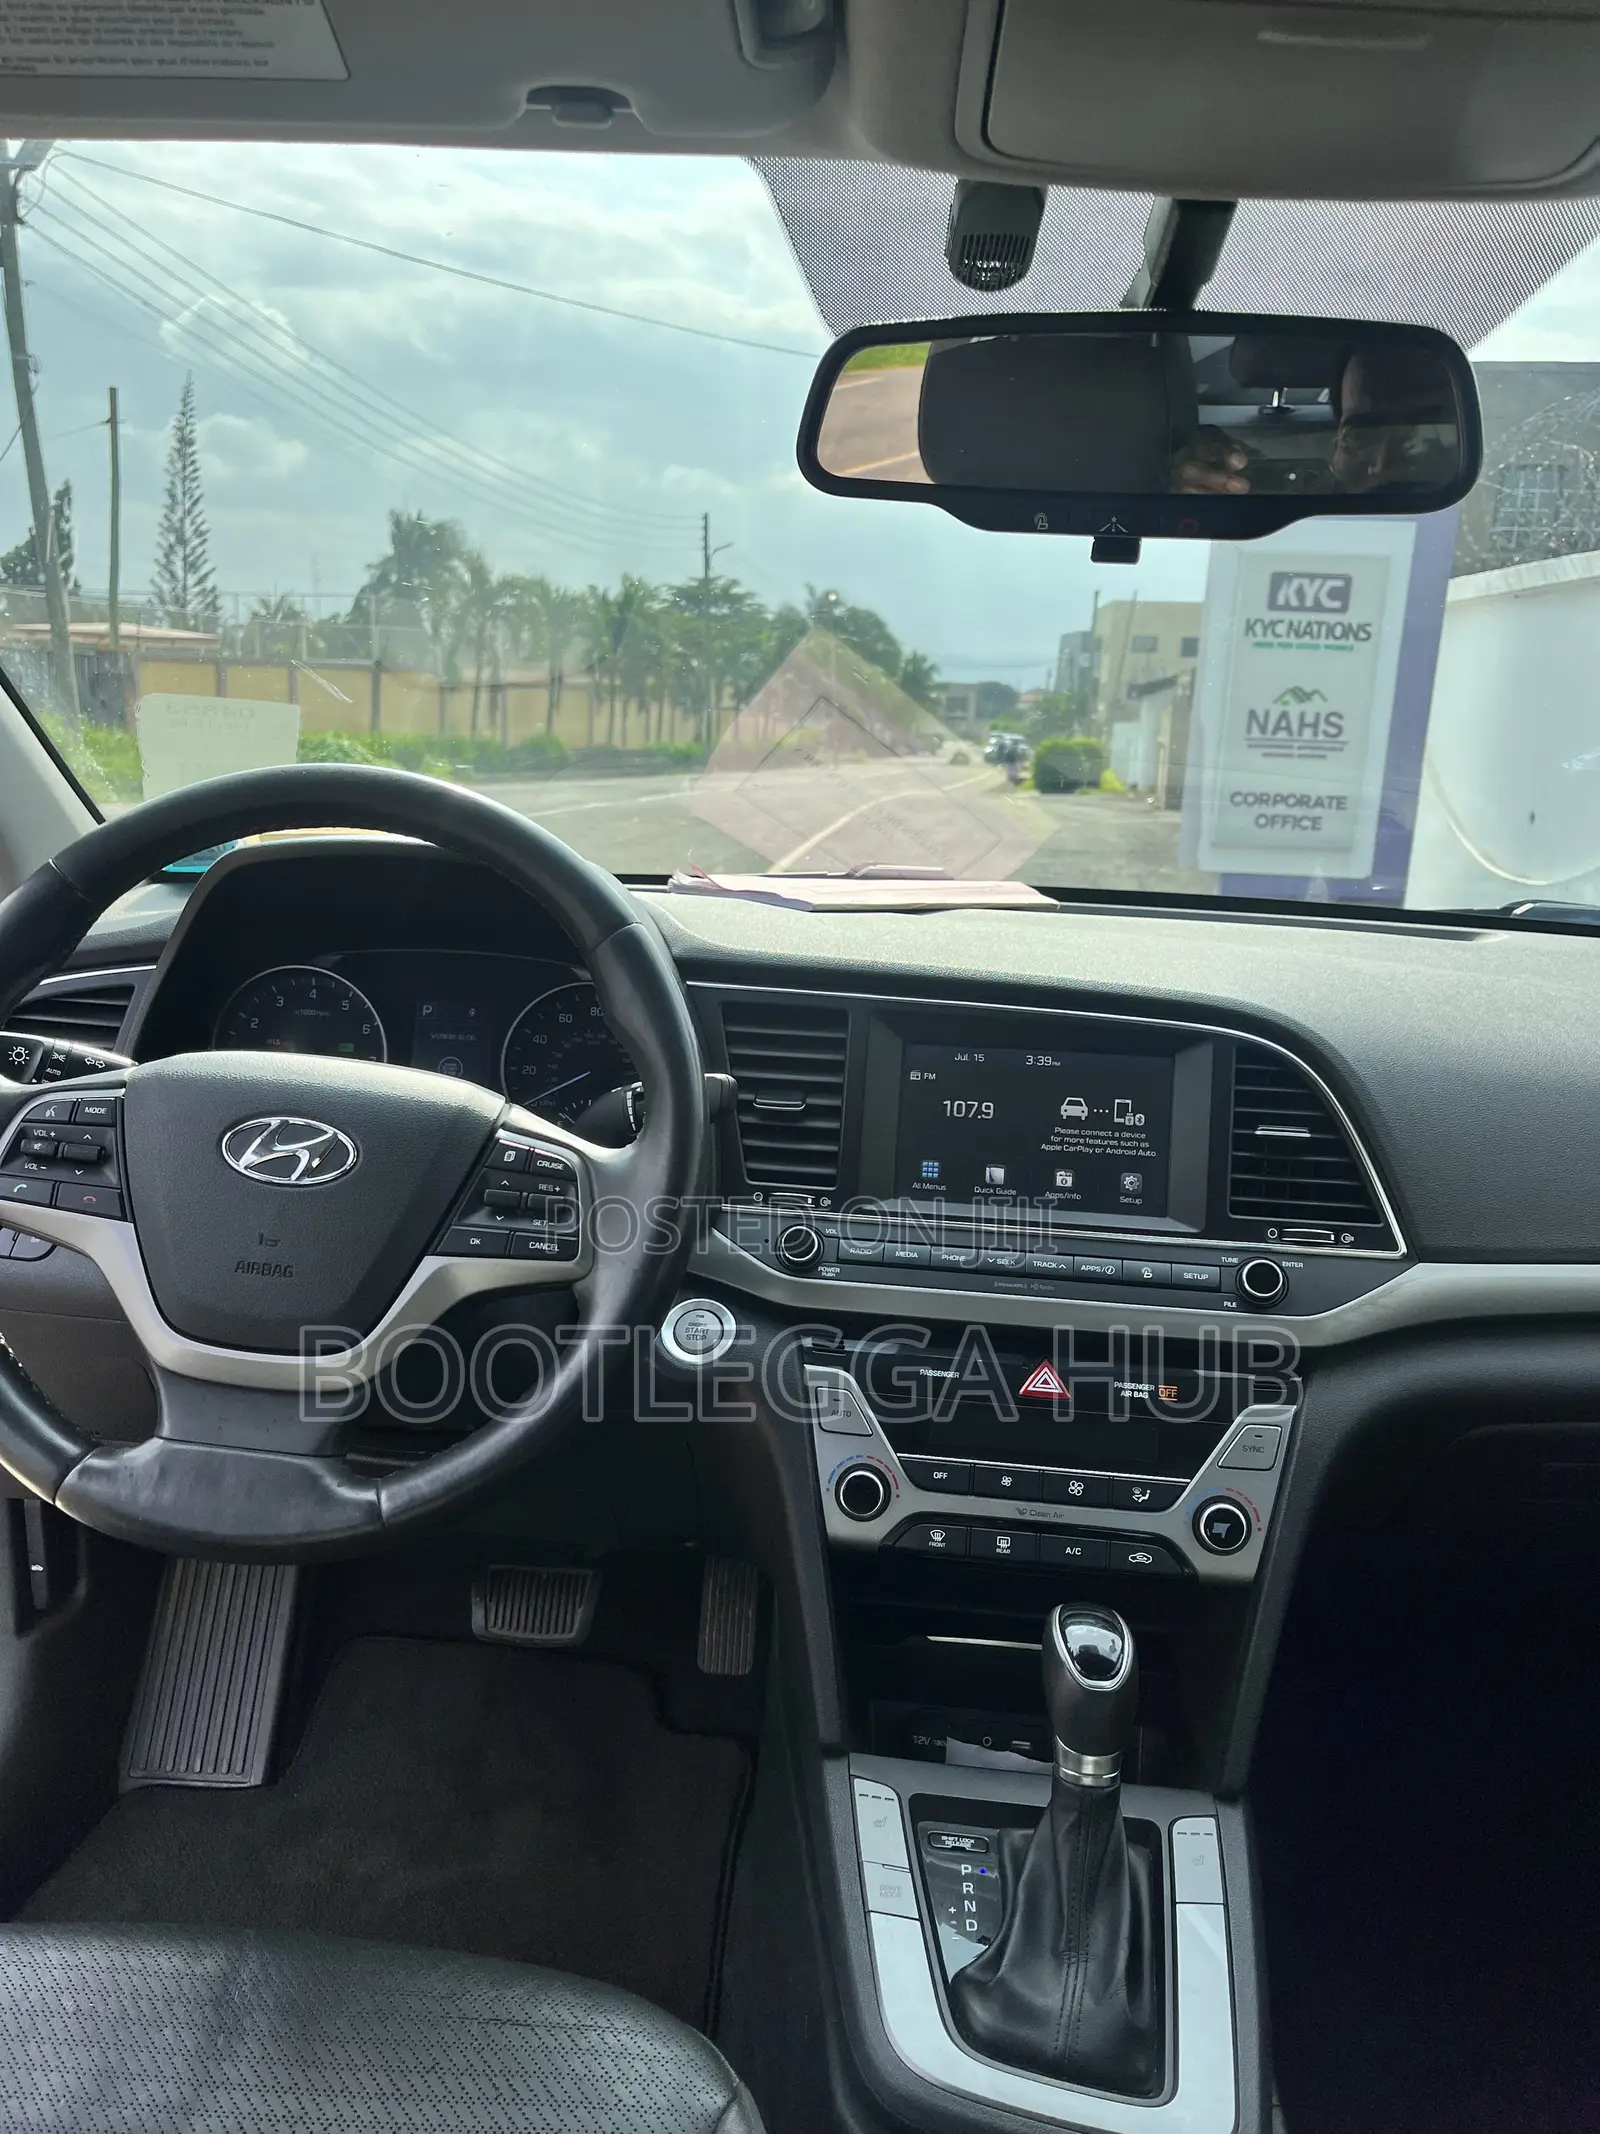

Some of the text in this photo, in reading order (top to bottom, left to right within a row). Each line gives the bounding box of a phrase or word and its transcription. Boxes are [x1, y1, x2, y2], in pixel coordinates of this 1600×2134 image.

[1276, 577, 1346, 609] KYC
[1245, 708, 1346, 740] NAHS
[1229, 790, 1348, 812] CORPORATE
[1254, 813, 1323, 832] OFFICE
[309, 988, 317, 1000] 4
[276, 996, 284, 1007] 3
[341, 1000, 350, 1011] 5
[422, 1004, 433, 1017] P
[250, 1017, 259, 1029] 2
[558, 1013, 573, 1023] 60
[362, 1023, 371, 1035] 6
[532, 1034, 548, 1044] 40
[973, 1053, 985, 1062] 15
[45, 1067, 62, 1077] AUTO
[522, 1065, 537, 1075] 20
[923, 1072, 936, 1081] FM
[84, 1106, 108, 1116] MODE
[942, 1100, 994, 1120] 107.9
[33, 1128, 49, 1138] VOL
[1054, 1126, 1080, 1136] Please
[1080, 1129, 1113, 1138] connect
[1120, 1130, 1146, 1140] device
[1050, 1135, 1150, 1149] for more features such as
[1040, 1143, 1157, 1158] Apple CarPlay or Android Auto
[24, 1161, 39, 1171] VOL
[536, 1159, 565, 1171] CRUISE
[538, 1183, 554, 1193] RES
[922, 1182, 947, 1191] Menus
[973, 1185, 1017, 1196] Quick Guide
[1044, 1190, 1082, 1201] Apps/Info
[1119, 1195, 1143, 1205] Setup
[532, 1218, 548, 1227] SET
[825, 1227, 838, 1235] VOL
[469, 1237, 482, 1246] OK
[528, 1241, 560, 1252] CANCEL
[849, 1247, 873, 1255] RADIO
[895, 1250, 919, 1259] MEDIA
[941, 1253, 967, 1263] PHONE
[996, 1257, 1016, 1266] SEEK
[1220, 1256, 1239, 1264] TUNE
[233, 1259, 295, 1279] AIRBAG
[1032, 1259, 1058, 1269] TRACK
[1281, 1260, 1304, 1269] ENTER
[817, 1265, 841, 1274] POWER
[1183, 1271, 1209, 1281] SETUP
[1223, 1300, 1238, 1309] FILE
[684, 1326, 710, 1335] START
[685, 1333, 708, 1341] STOP
[919, 1368, 960, 1379] PASSENGER
[1113, 1381, 1156, 1392] PASSENGER
[1120, 1389, 1149, 1399] AIR BAG
[1158, 1387, 1178, 1399] OFF
[830, 1408, 852, 1418] AUTO
[1242, 1444, 1265, 1454] SYNC
[933, 1471, 948, 1480] OFF
[1029, 1508, 1065, 1519] Clean Air
[928, 1541, 947, 1549] FRONT
[1065, 1546, 1082, 1556] A/C
[913, 1735, 931, 1745] 12V
[961, 1864, 972, 1876] P
[962, 1882, 974, 1894] R
[964, 1900, 977, 1912] N
[965, 1919, 978, 1932] D
